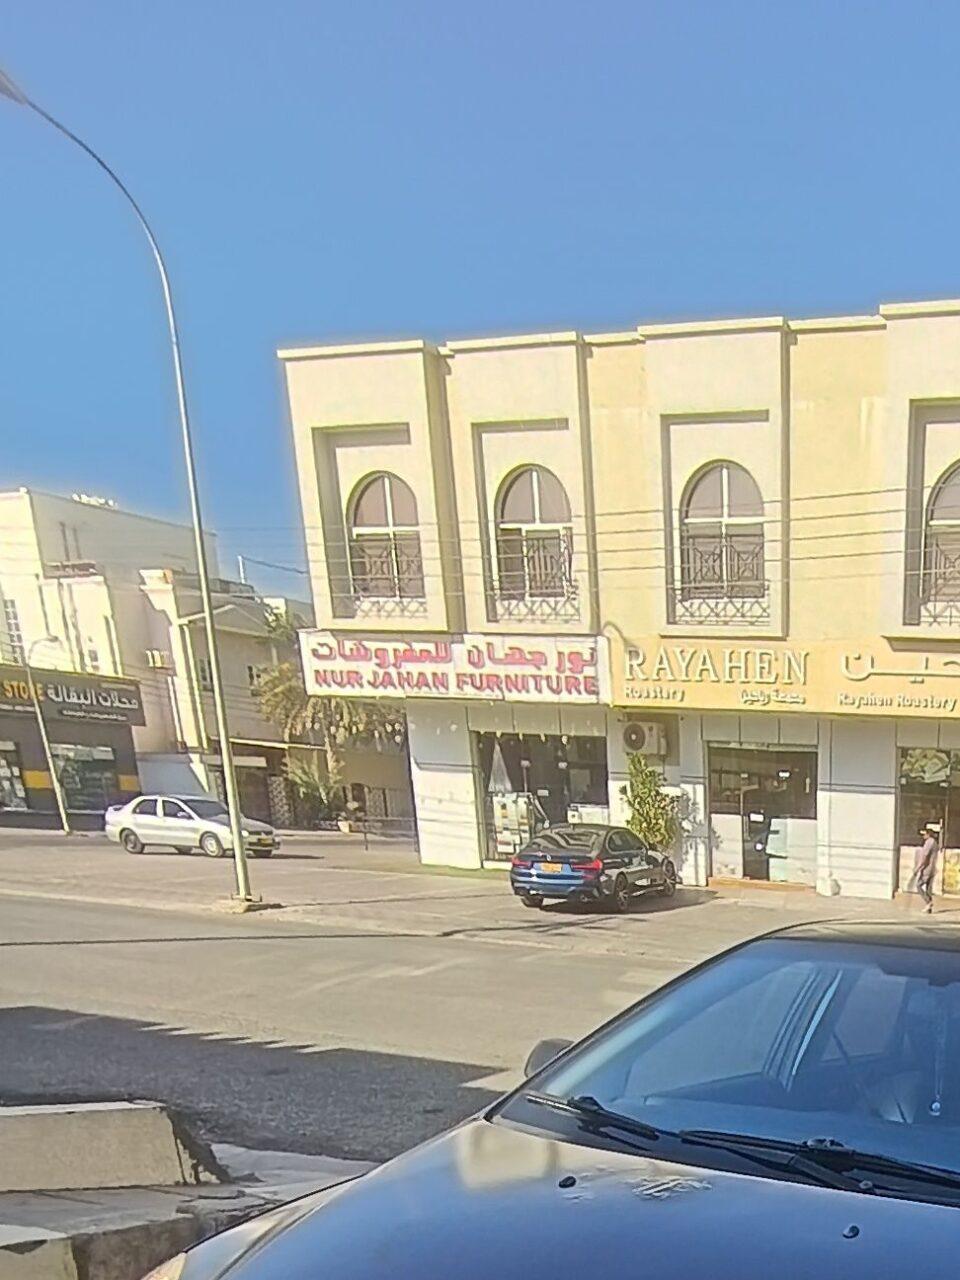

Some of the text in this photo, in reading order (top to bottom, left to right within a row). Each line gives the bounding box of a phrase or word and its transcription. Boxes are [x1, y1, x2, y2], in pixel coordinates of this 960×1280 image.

[310, 639, 452, 670] للمفروشات
[624, 645, 810, 686] RAYAHEN
[3, 680, 44, 701] STOE
[314, 669, 599, 695] NUR JAHAN FURNITURE
